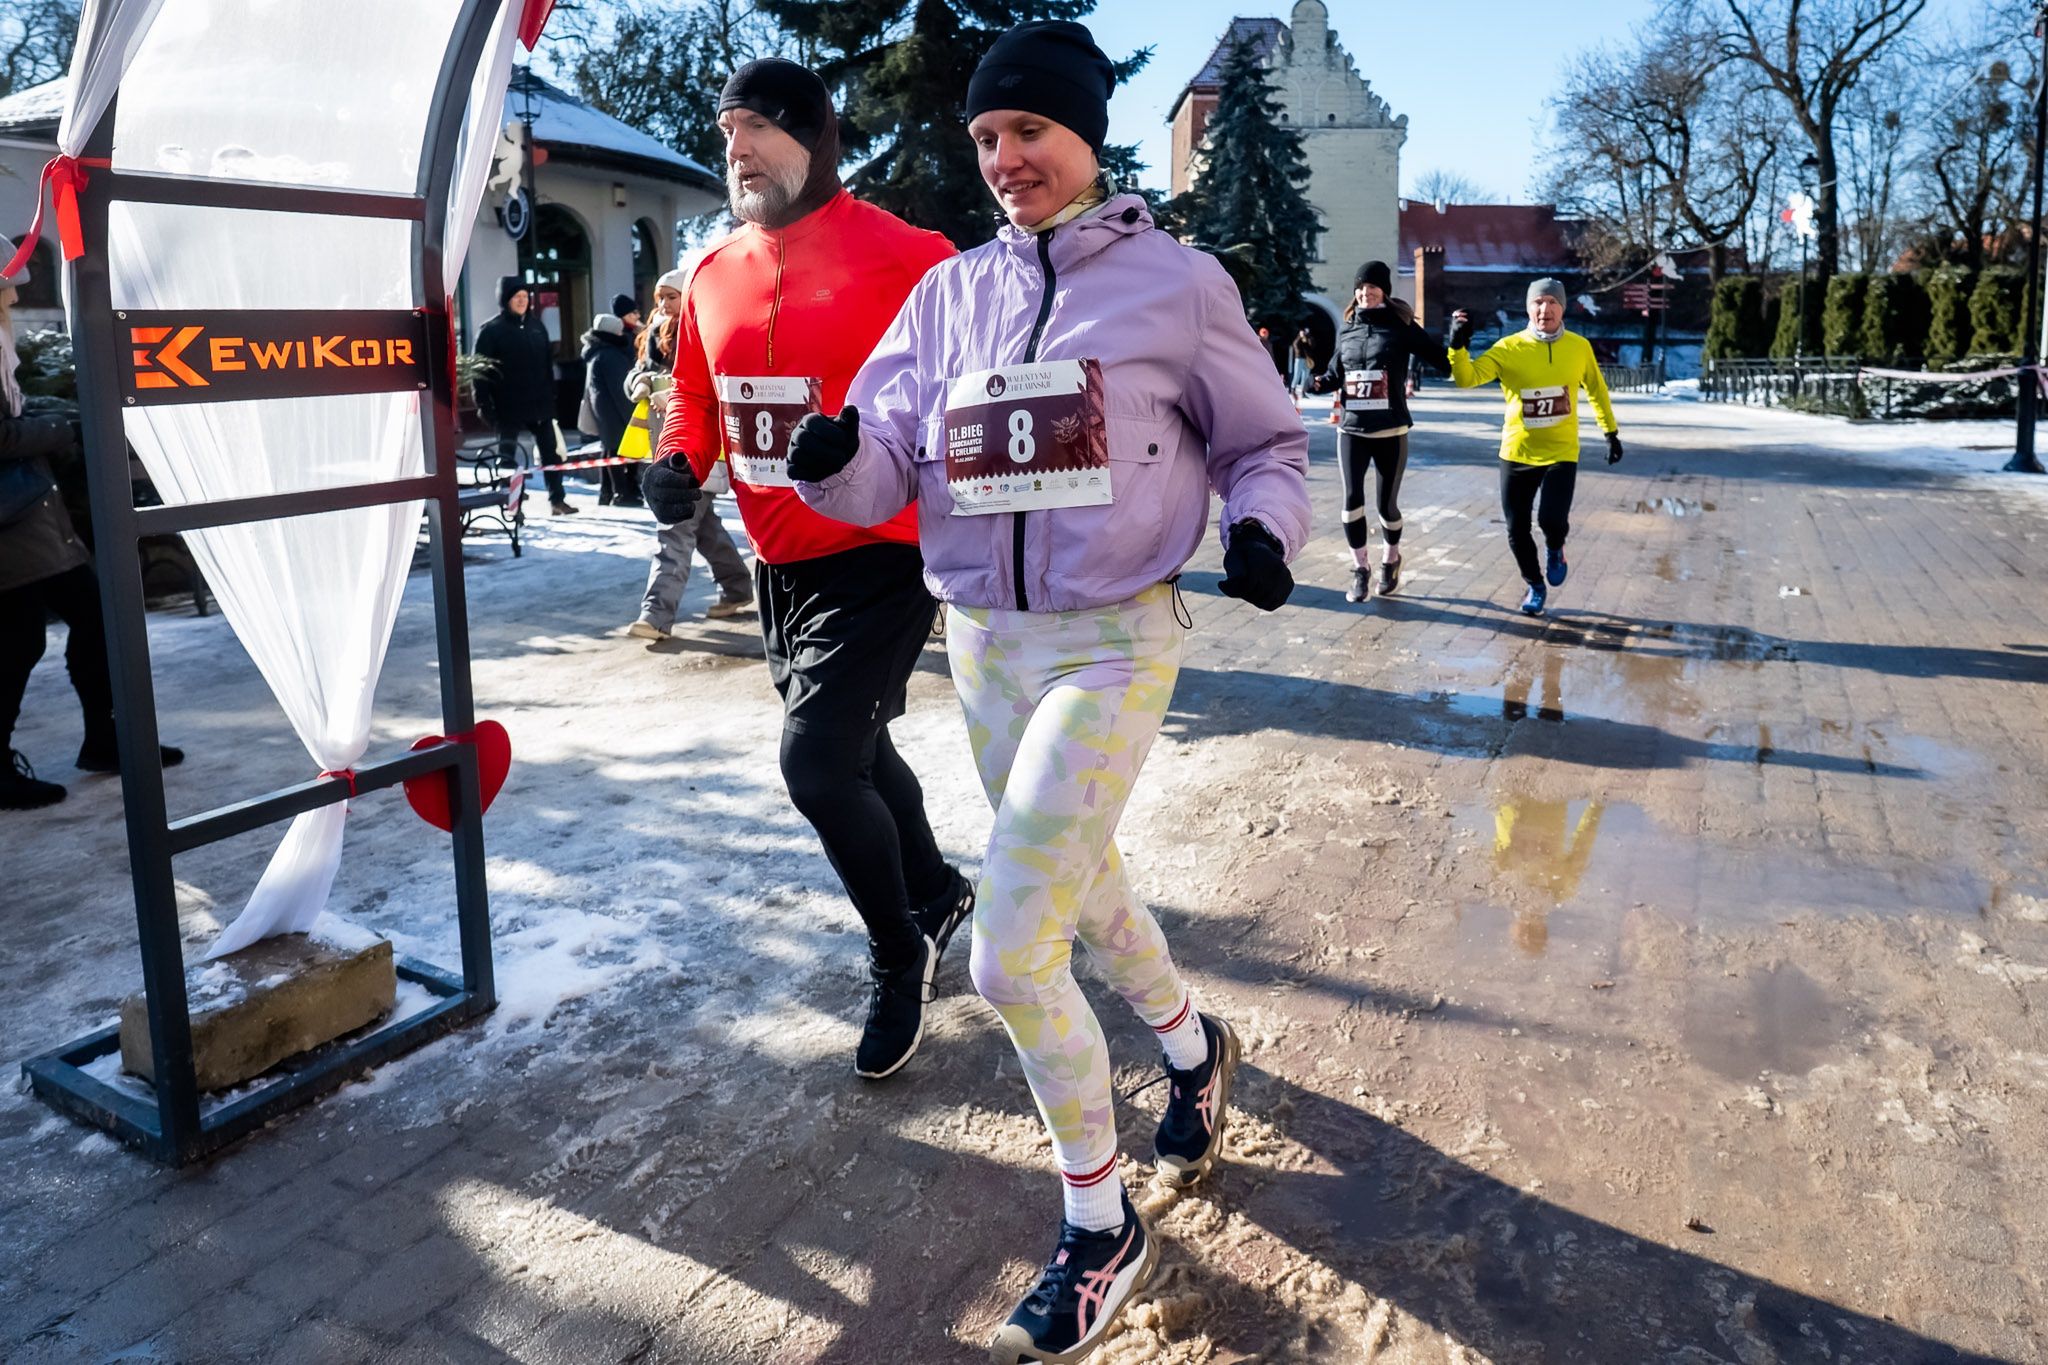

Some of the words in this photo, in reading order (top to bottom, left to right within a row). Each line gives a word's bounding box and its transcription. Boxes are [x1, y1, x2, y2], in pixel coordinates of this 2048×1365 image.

[1357, 382, 1372, 398] 27
[1537, 399, 1554, 415] 27
[755, 410, 774, 452] 8
[1008, 409, 1035, 463] 8
